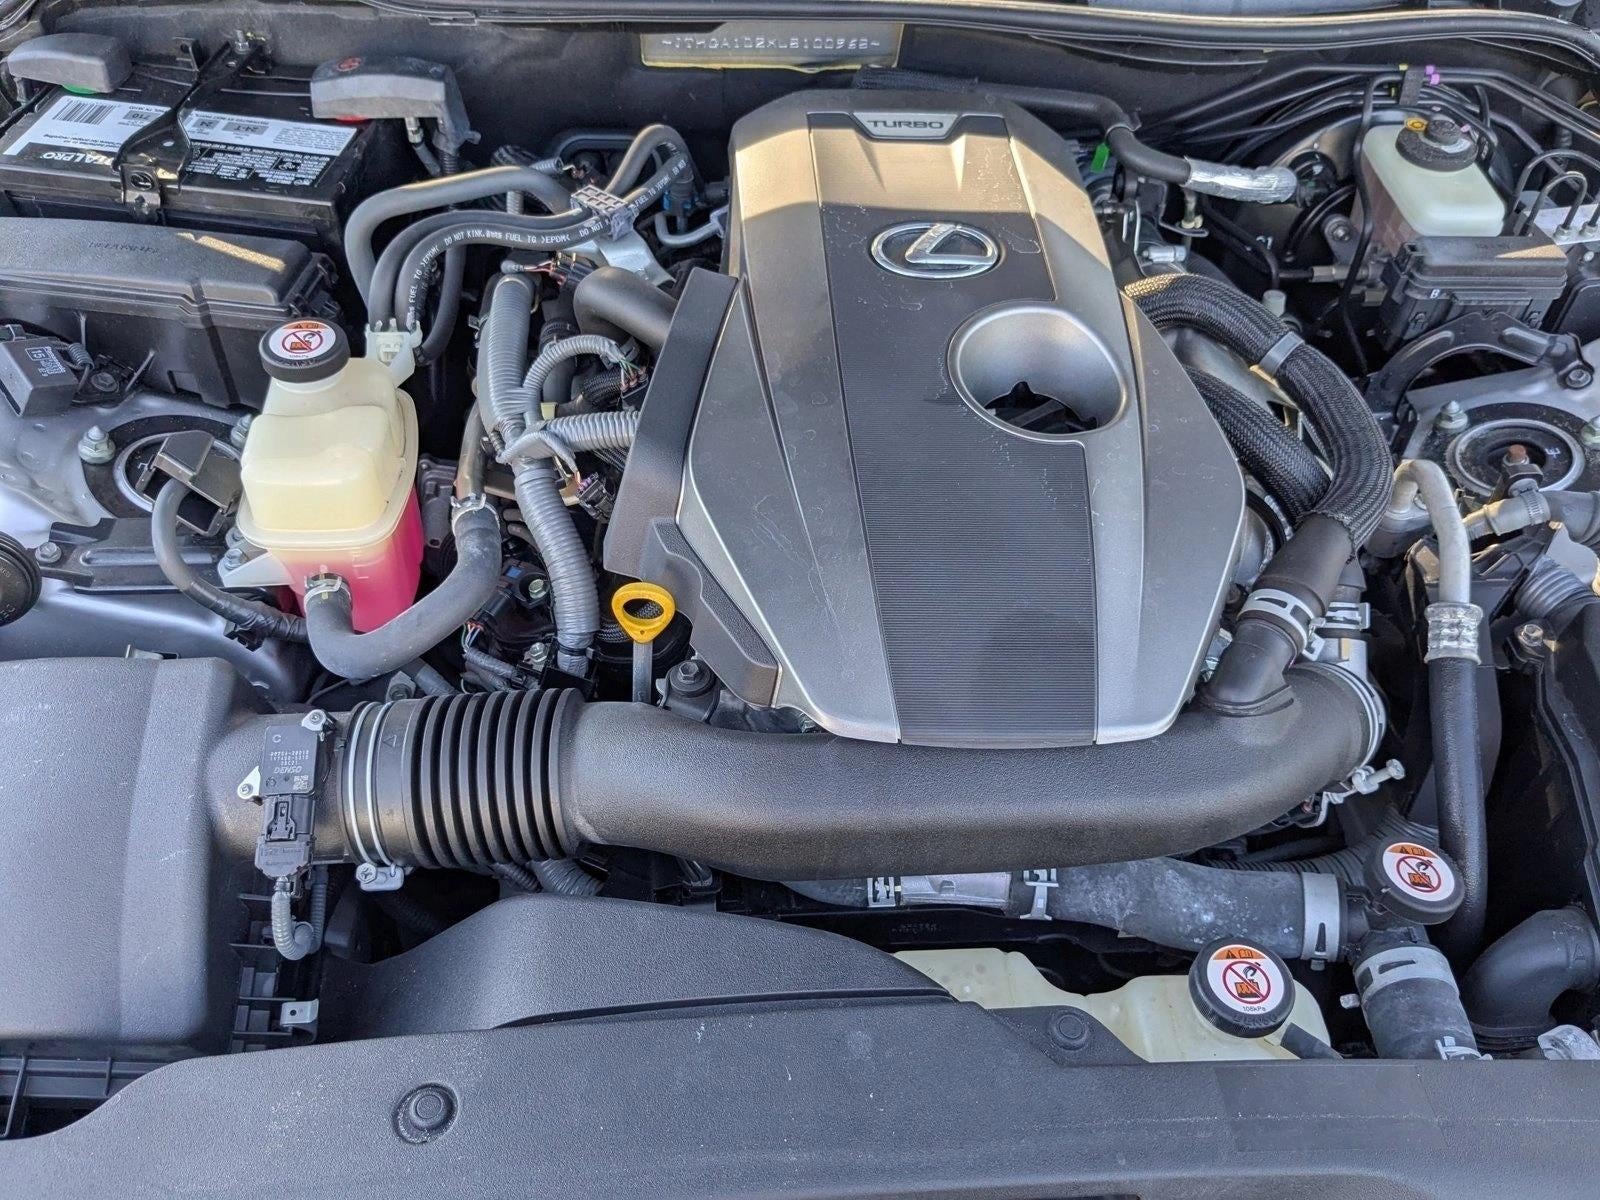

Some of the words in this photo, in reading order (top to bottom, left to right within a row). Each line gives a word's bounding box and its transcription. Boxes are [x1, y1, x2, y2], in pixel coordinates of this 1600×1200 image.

[867, 120, 944, 129] TURBO
[409, 284, 418, 303] FUEL
[444, 236, 453, 246] DO
[453, 231, 465, 241] NOT
[505, 232, 521, 242] FUEL
[579, 228, 589, 237] DO
[591, 222, 603, 232] NOT
[272, 734, 281, 743] C
[274, 766, 302, 774] DENSO
